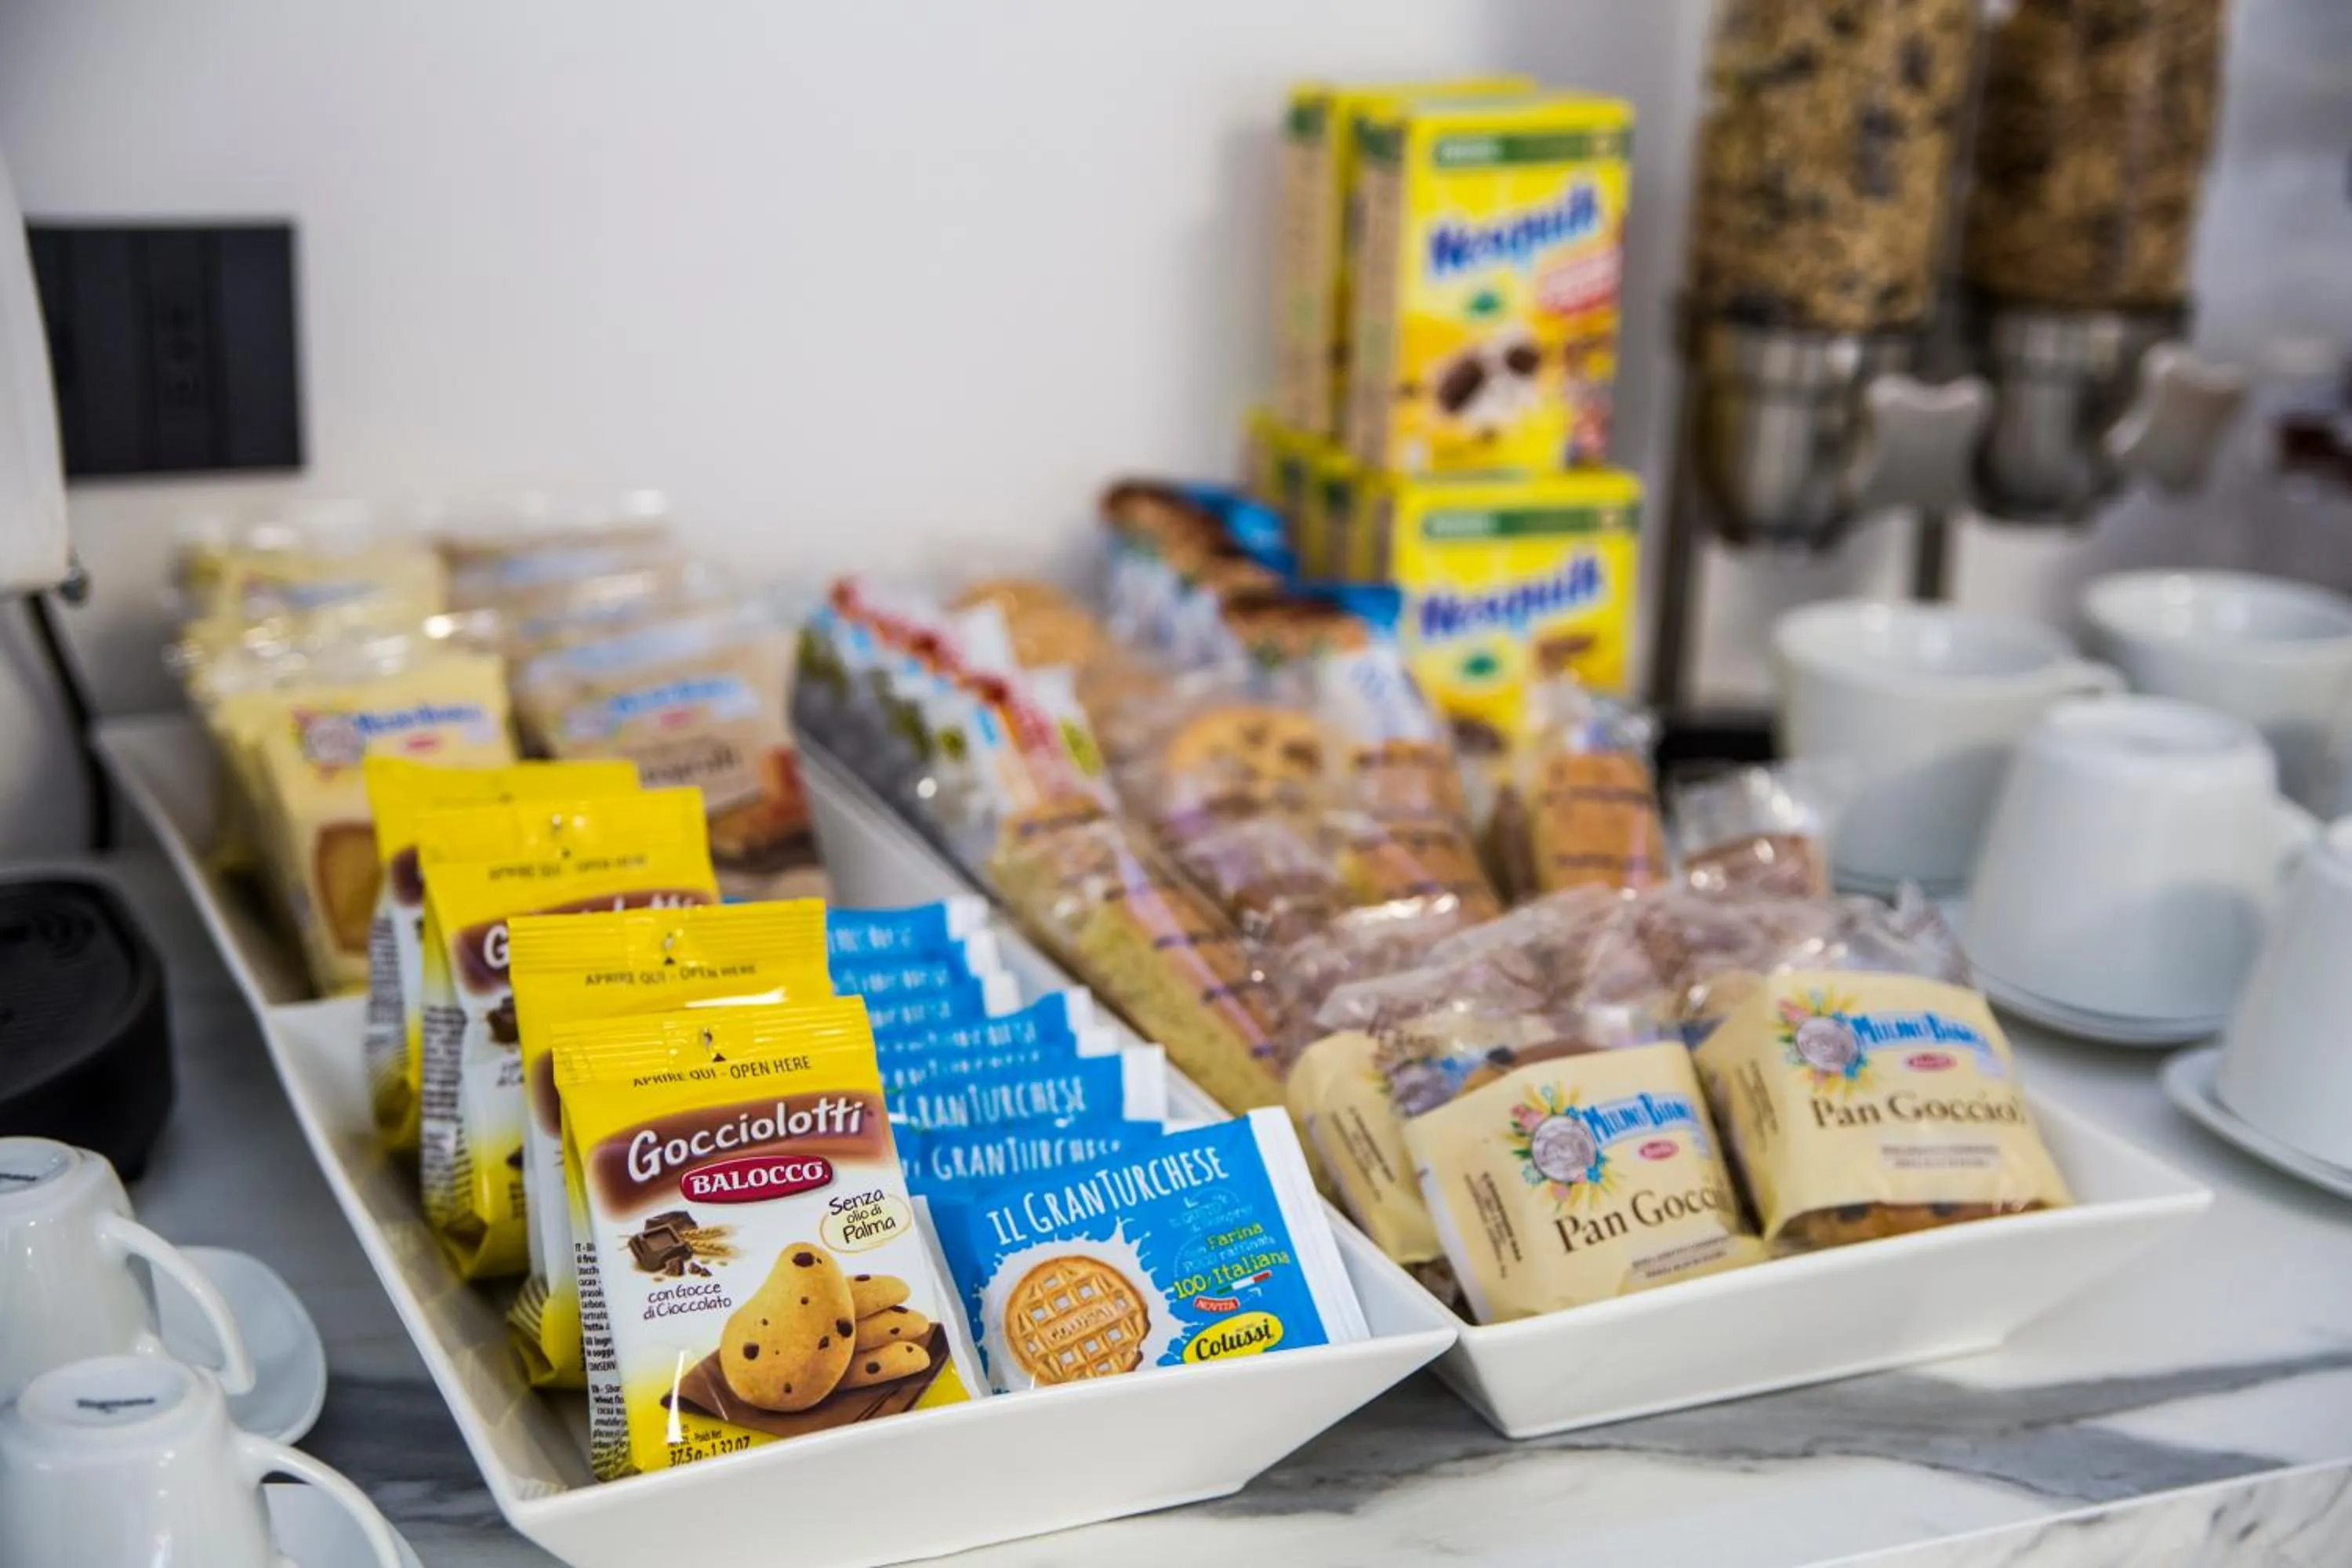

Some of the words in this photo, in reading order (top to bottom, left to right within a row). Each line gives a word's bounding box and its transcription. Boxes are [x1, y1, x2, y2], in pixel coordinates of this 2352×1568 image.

[689, 1069, 717, 1081] QUI
[730, 1062, 771, 1080] OPEN
[773, 1054, 812, 1073] HERE
[1811, 1098, 1882, 1130] Pan
[627, 1096, 864, 1184] Gocciolotti
[689, 1160, 824, 1196] BALOCCO
[829, 1189, 885, 1216] Senza
[847, 1209, 869, 1224] olio
[870, 1203, 882, 1217] di
[842, 1216, 896, 1244] Palma
[1205, 1221, 1265, 1248] Farina
[1552, 1208, 1630, 1255] Pan
[1210, 1250, 1290, 1286] Italiana
[648, 1289, 675, 1303] con
[675, 1283, 721, 1299] Gocce
[643, 1305, 656, 1320] di
[656, 1295, 732, 1317] Cioccolato
[1195, 1318, 1273, 1361] Colussi
